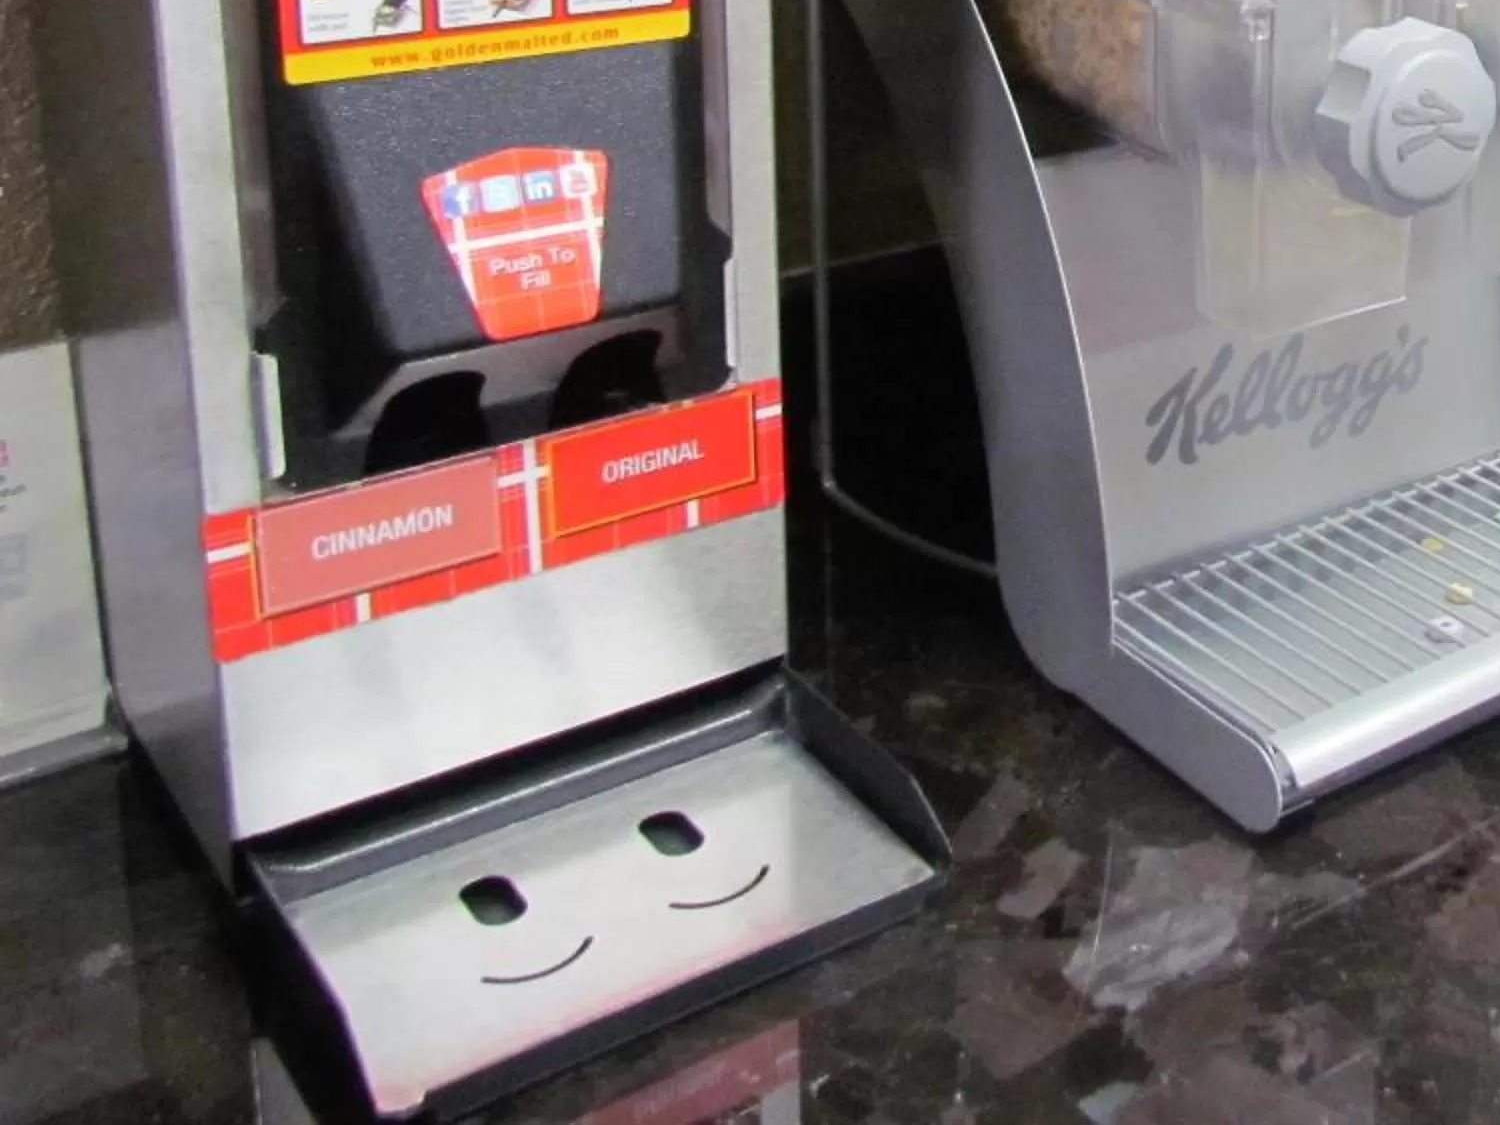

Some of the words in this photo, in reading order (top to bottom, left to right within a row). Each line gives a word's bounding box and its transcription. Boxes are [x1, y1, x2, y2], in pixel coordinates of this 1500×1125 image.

[370, 26, 620, 68] www.goldenmalted.com
[488, 253, 543, 275] Push
[548, 247, 576, 263] To
[520, 271, 551, 291] Fill
[1145, 323, 1430, 466] Kellogg's
[602, 438, 706, 485] ORIGINAL
[311, 504, 454, 561] CINNAMON
